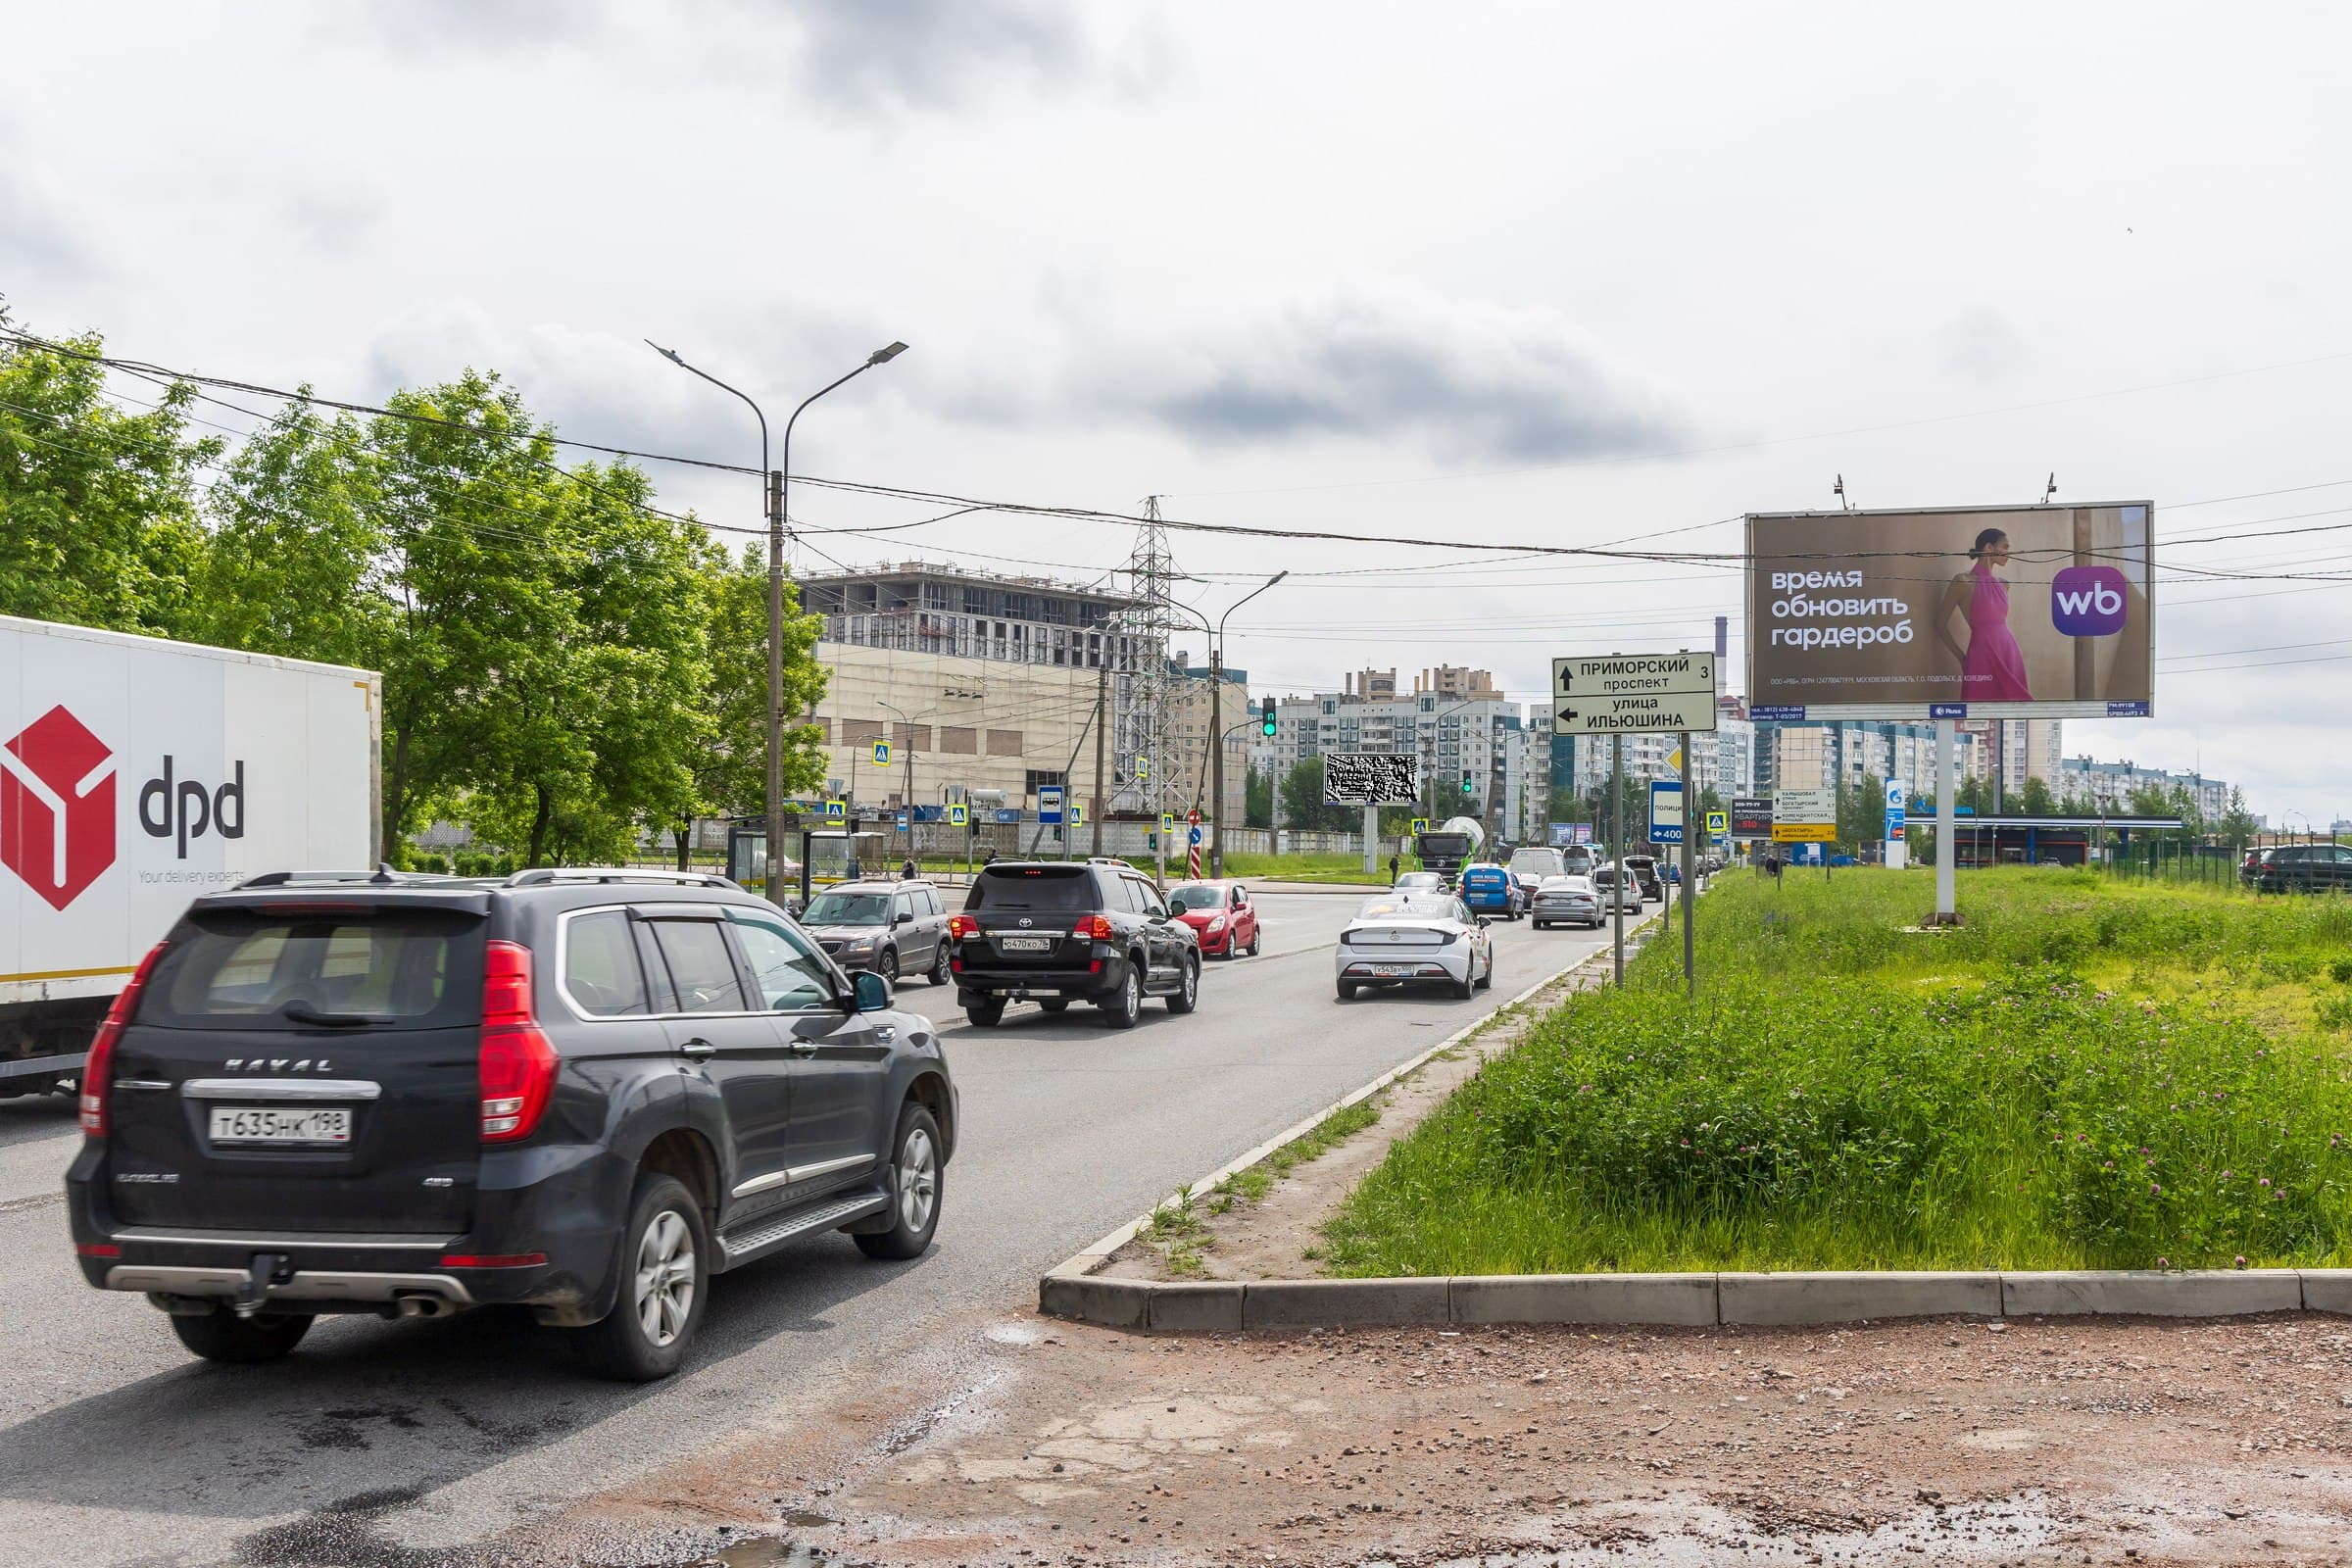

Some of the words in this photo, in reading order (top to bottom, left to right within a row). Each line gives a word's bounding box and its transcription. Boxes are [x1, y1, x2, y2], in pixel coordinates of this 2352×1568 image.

[1772, 570, 1862, 595] время
[1771, 593, 1908, 617] обновить
[2056, 580, 2122, 615] wb
[1772, 619, 1913, 651] гардероб
[1581, 657, 1690, 675] ПРИМОРСКИЙ
[1700, 666, 1709, 678] 3
[1603, 678, 1669, 692] проспект
[1613, 698, 1658, 712] улица
[1587, 713, 1685, 728] ИЛЬЮШИНА
[139, 755, 243, 858] dpd
[1663, 830, 1682, 839] 400
[139, 870, 164, 883] Your
[165, 870, 206, 885] delivery
[206, 871, 244, 884] experts
[223, 1058, 333, 1072] HAVAL
[220, 1112, 307, 1136] Т635НК
